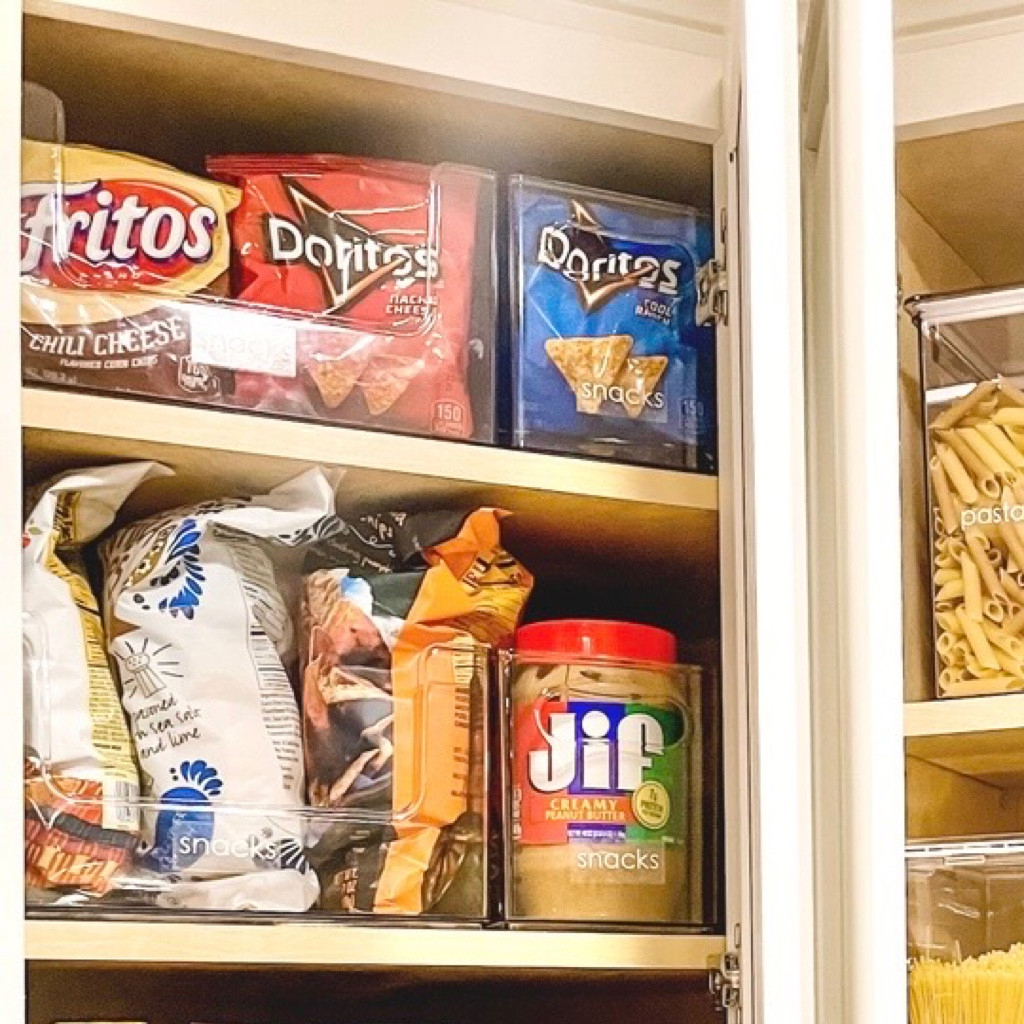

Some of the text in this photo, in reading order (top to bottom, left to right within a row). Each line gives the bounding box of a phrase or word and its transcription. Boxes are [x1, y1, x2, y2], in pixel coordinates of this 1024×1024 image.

[268, 217, 439, 279] Doritos
[538, 226, 681, 295] Doritos
[29, 317, 187, 356] CHILI CHEESE
[582, 380, 665, 409] snacks
[437, 404, 462, 421] 150
[961, 503, 1024, 530] pasta
[528, 710, 665, 792] Jif
[545, 810, 626, 821] PEANUT BUTTER
[551, 799, 618, 811] CREAMY
[179, 834, 276, 859] snacks
[578, 849, 660, 869] snacks
